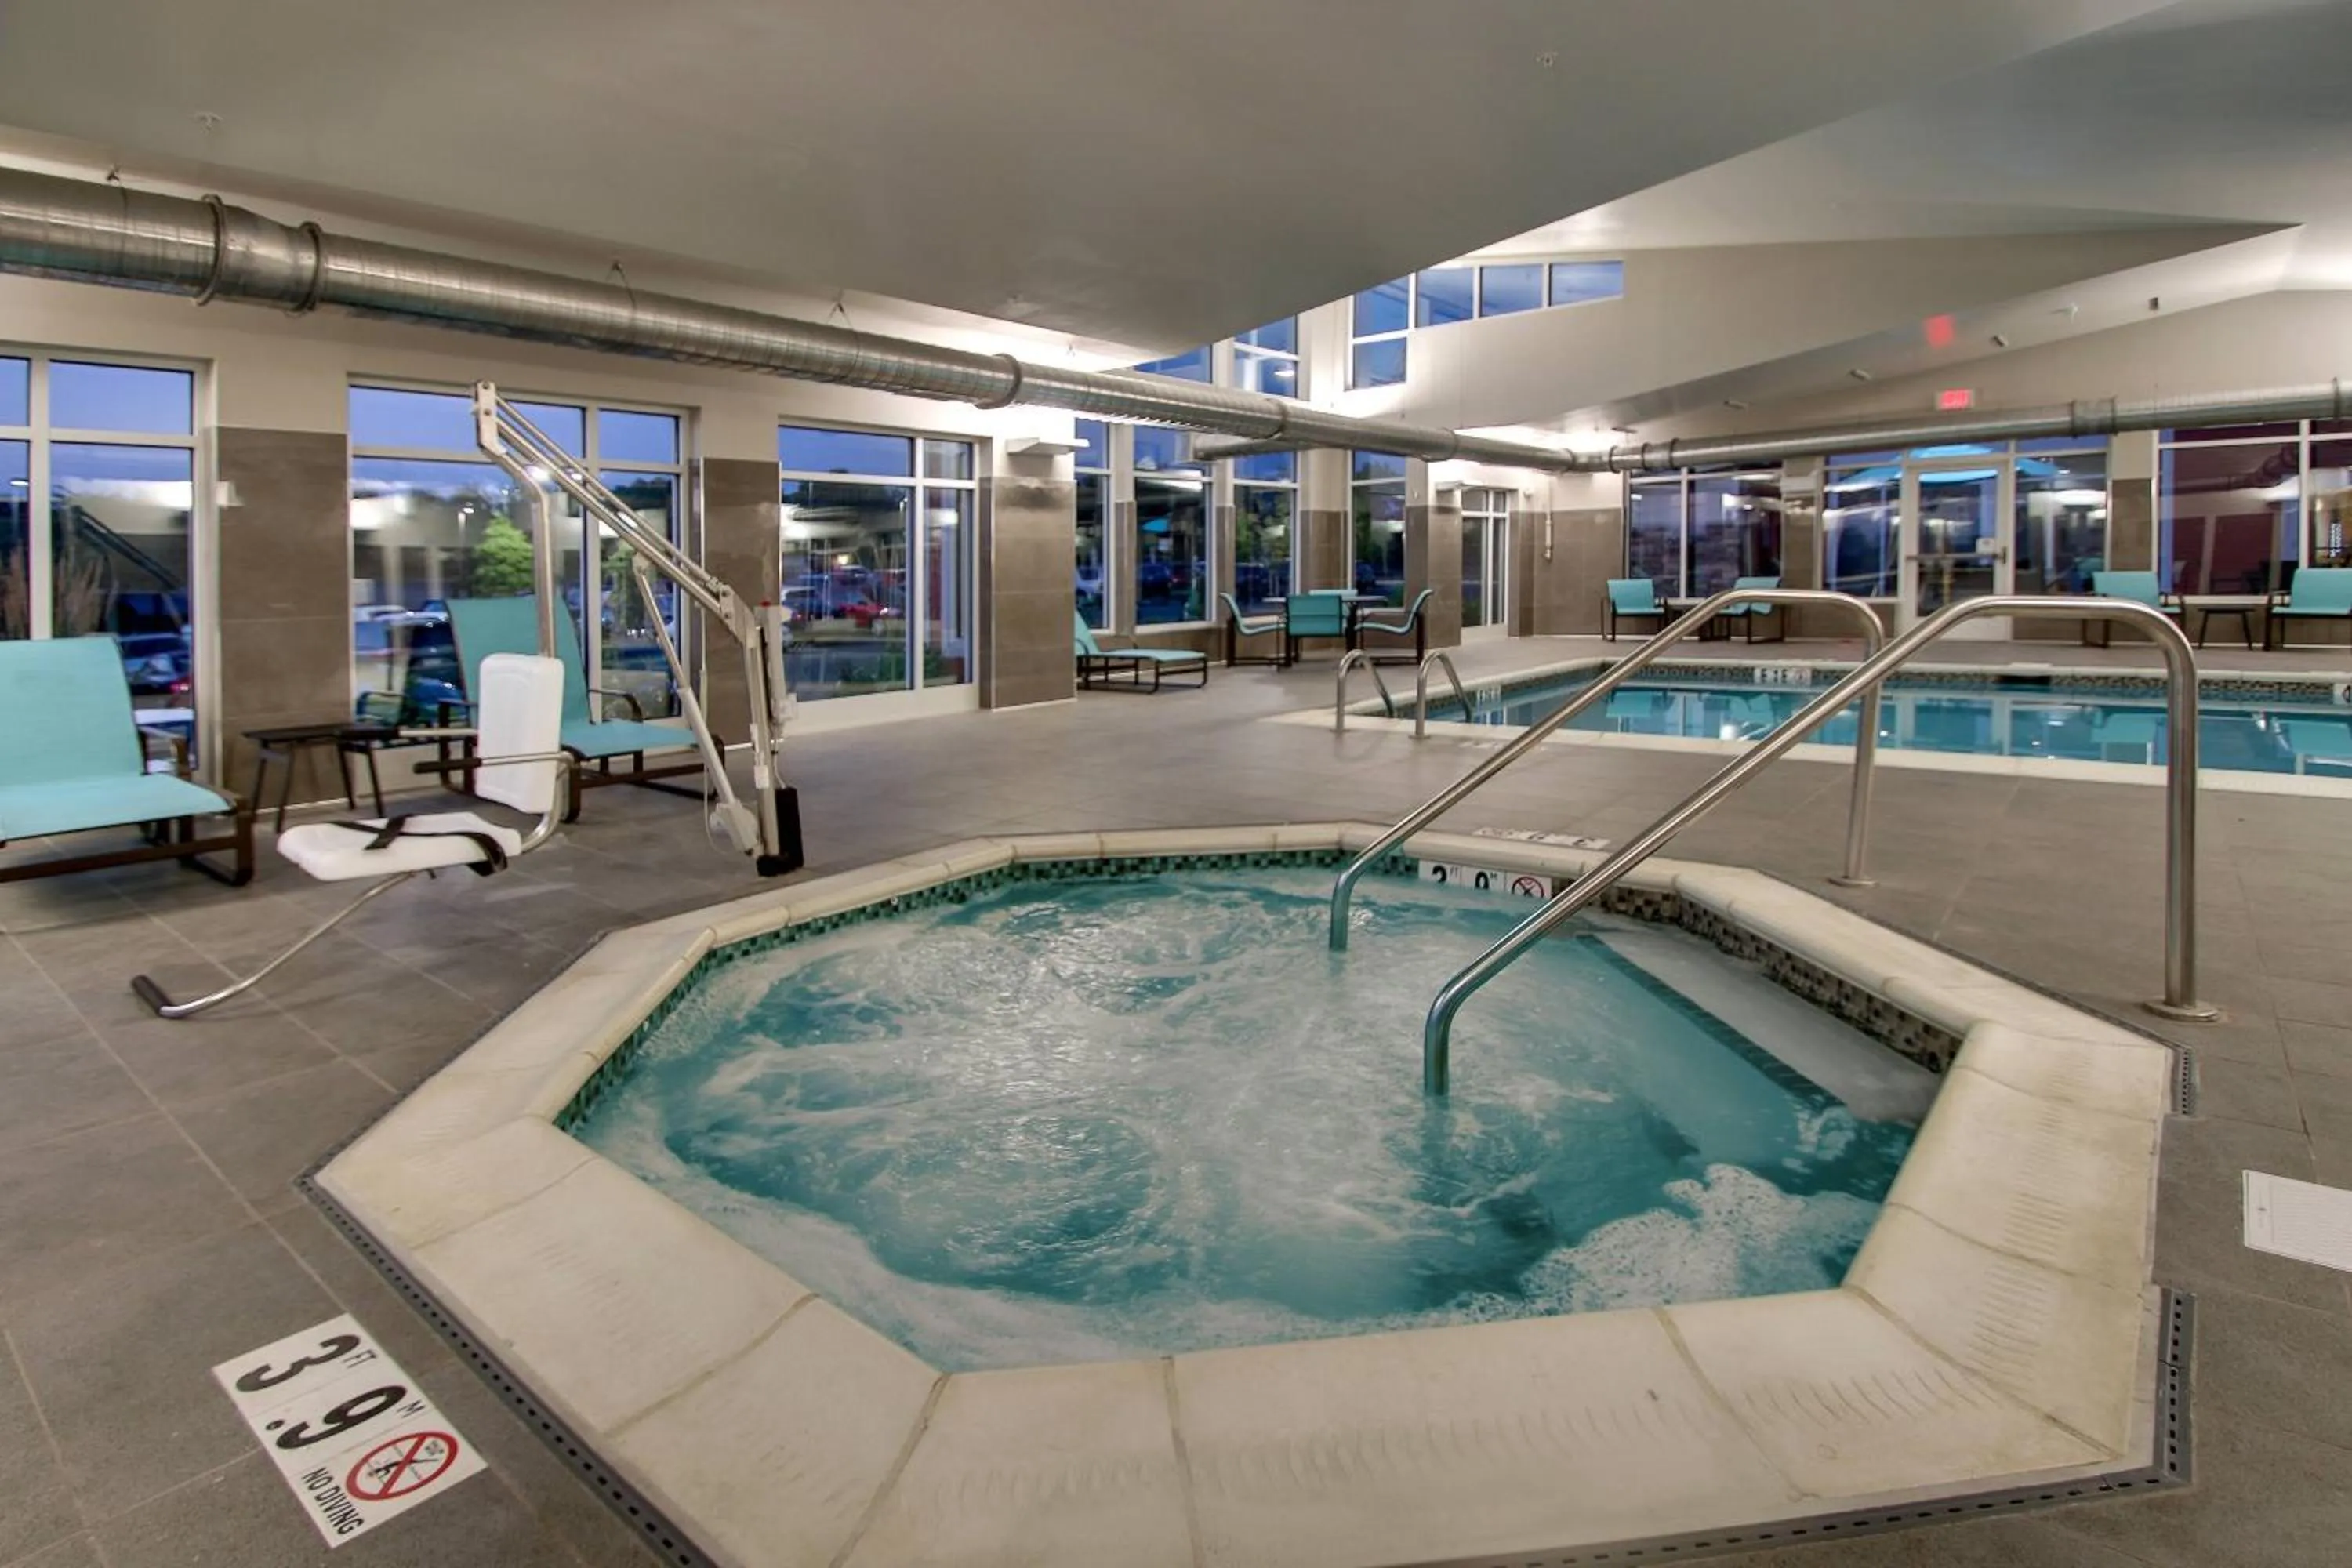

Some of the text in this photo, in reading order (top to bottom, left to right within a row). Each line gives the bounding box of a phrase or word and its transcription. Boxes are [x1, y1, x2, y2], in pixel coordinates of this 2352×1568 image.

[235, 1334, 377, 1392] 3 FT
[265, 1385, 426, 1449] .9 M
[301, 1467, 364, 1534] NO DIVING
